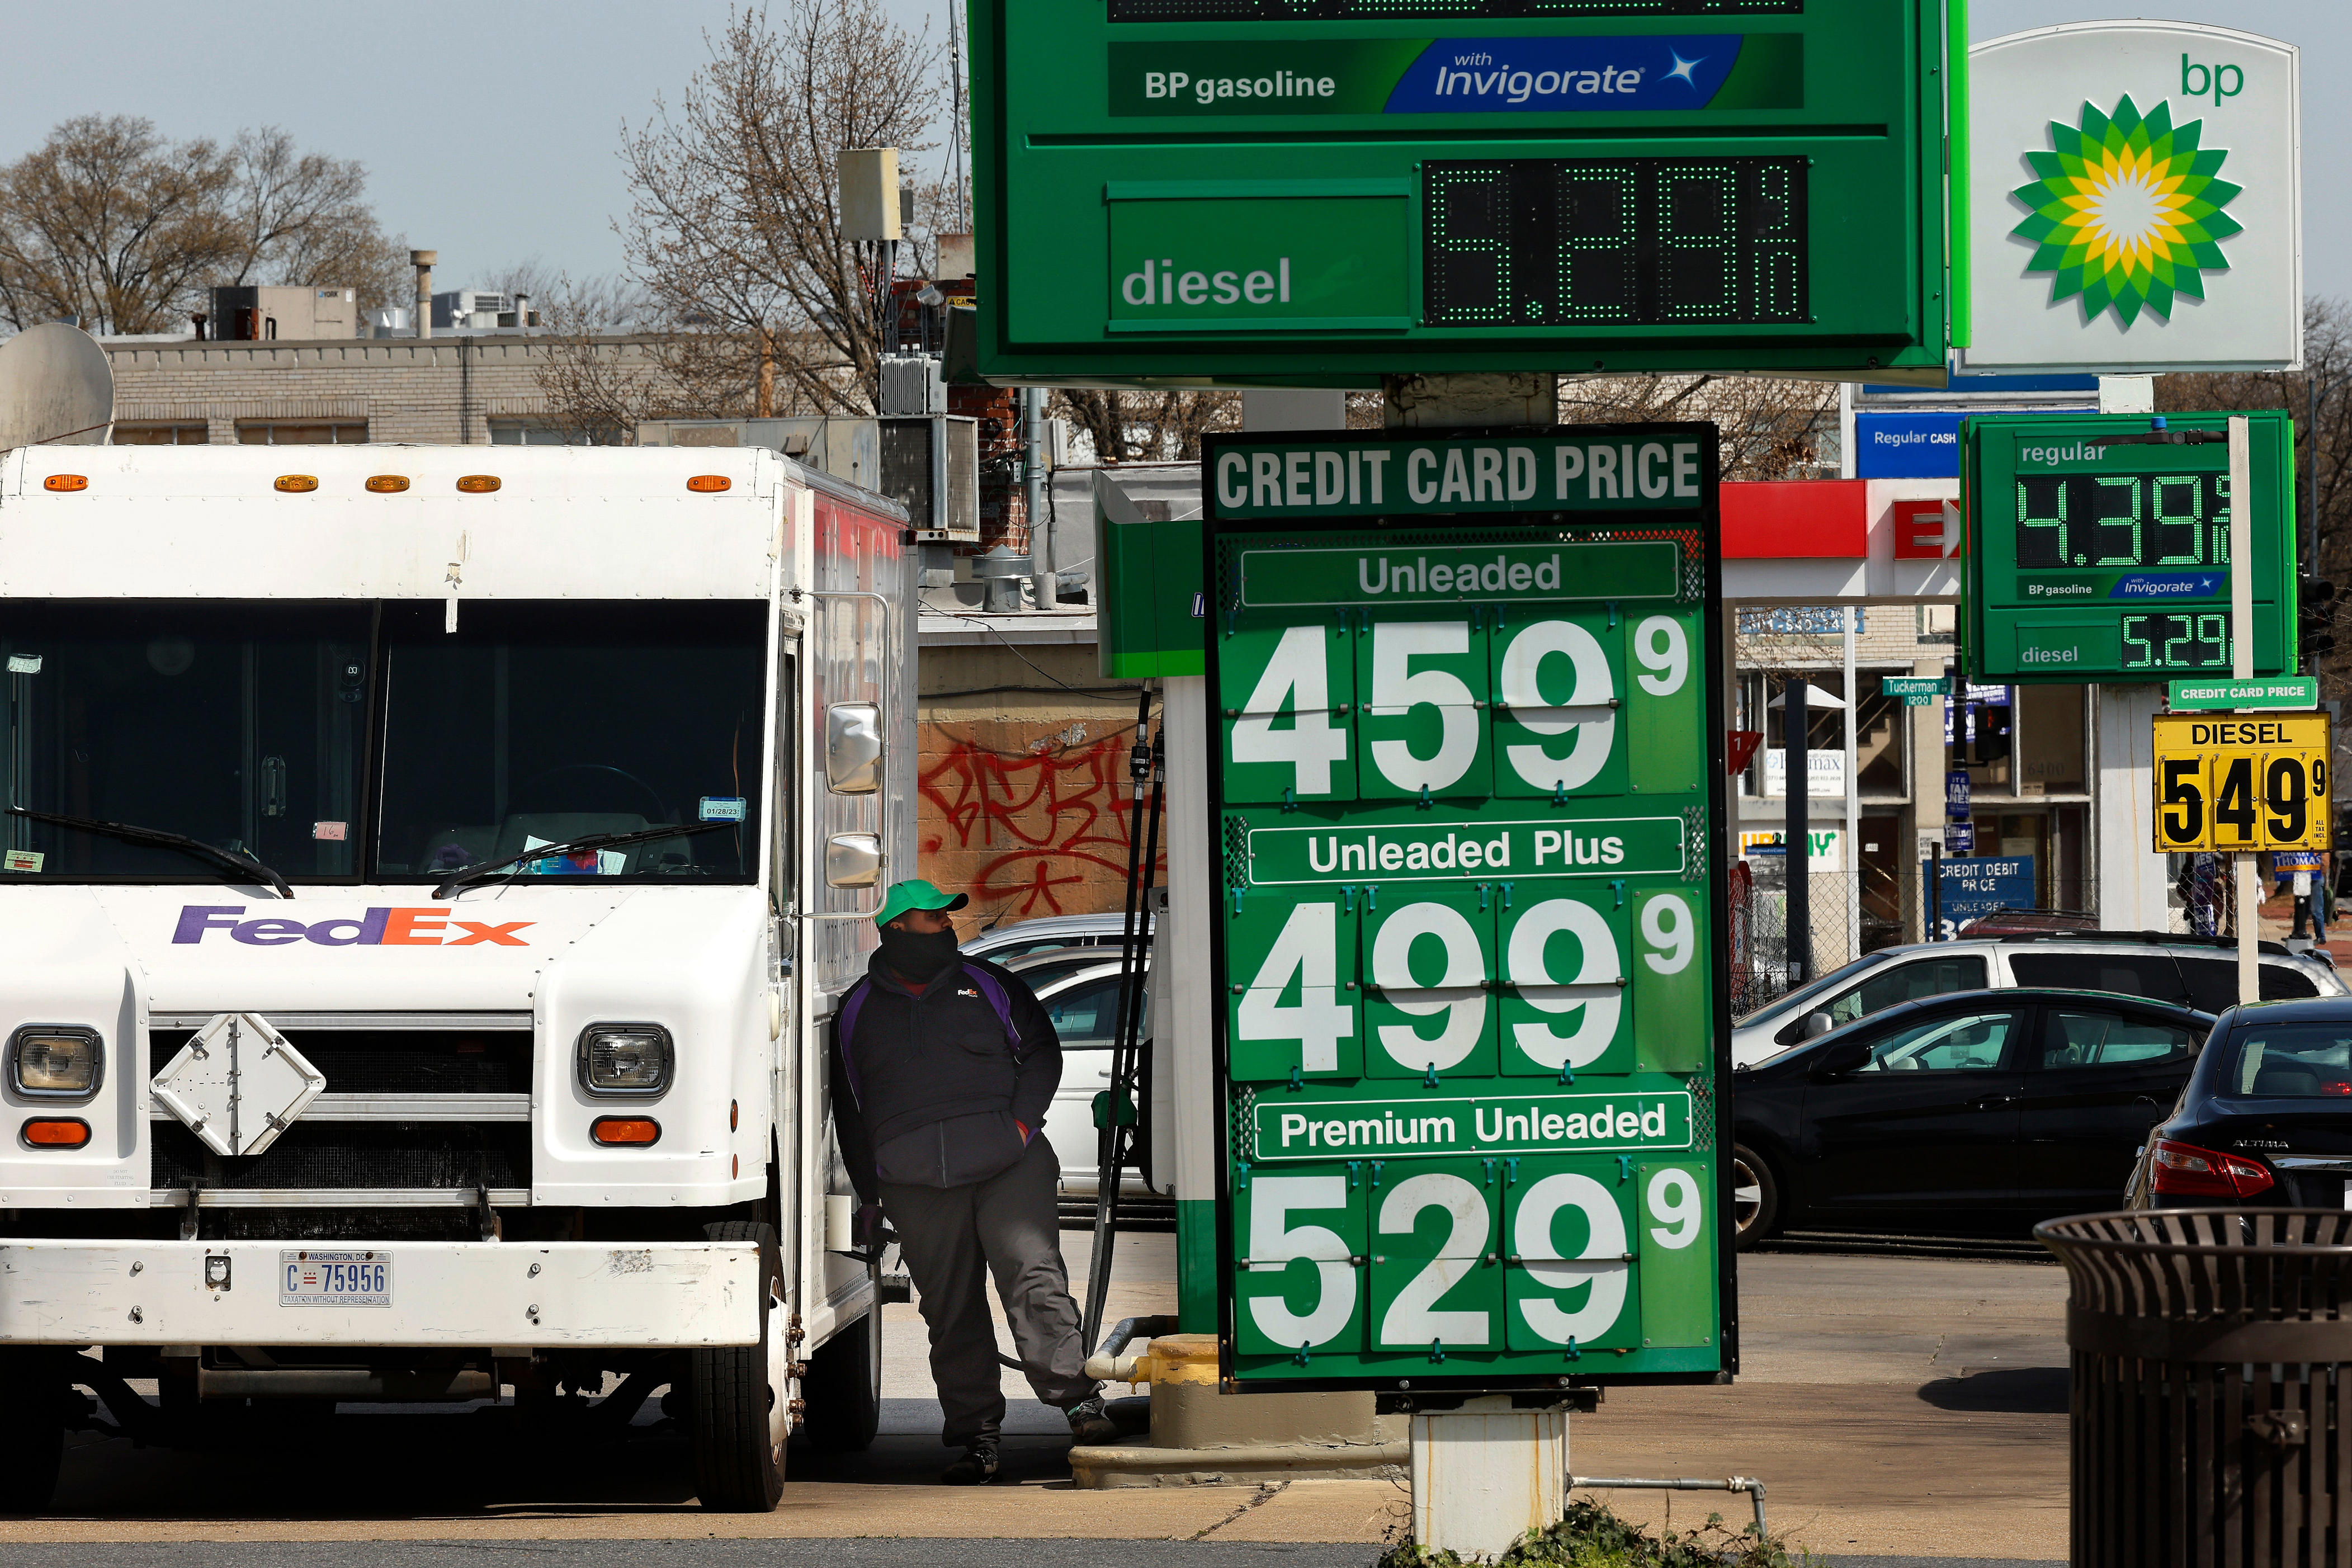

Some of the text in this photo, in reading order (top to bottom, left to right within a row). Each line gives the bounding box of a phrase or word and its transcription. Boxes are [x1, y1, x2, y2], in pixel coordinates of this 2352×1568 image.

[1454, 51, 1492, 67] with
[1145, 72, 1189, 99] BP
[1196, 70, 1336, 105] gasoline
[2181, 53, 2244, 107] bp
[1432, 167, 1737, 320] 5.29
[1121, 257, 1291, 305] diesel
[1874, 430, 1957, 447] Regular CASH
[2022, 441, 2107, 466] regular
[1216, 442, 1699, 508] CREDIT CARD PRICE
[2018, 476, 2202, 566] 4.39
[1358, 554, 1561, 594] Unleaded
[2028, 584, 2044, 594] BP
[2046, 584, 2093, 597] gasoline
[2022, 646, 2079, 663] diesel
[2123, 615, 2226, 667] 5.29
[1888, 679, 1938, 693] Tuckerman
[1908, 696, 1928, 705] 1200
[2180, 686, 2305, 699] CREDIT CARD PRICE
[1231, 620, 1614, 794] 459
[1633, 615, 1688, 696] 9
[2192, 723, 2293, 745] DIESEL
[2028, 762, 2065, 776] 6400
[2164, 757, 2326, 843] 549 9
[1309, 830, 1625, 873] Unleaded Plus
[2274, 856, 2321, 866] THOMAS
[1939, 862, 2019, 878] CREDIT DEBIT
[1962, 879, 1996, 891] PRCE
[171, 905, 537, 946] FedEx
[1238, 894, 1694, 1072] 499 9
[1281, 1103, 1666, 1147] Premium Unleaded
[2233, 1140, 2289, 1149] ALTIMA
[1249, 1168, 1701, 1348] 529 9
[287, 1264, 384, 1292] C 75956
